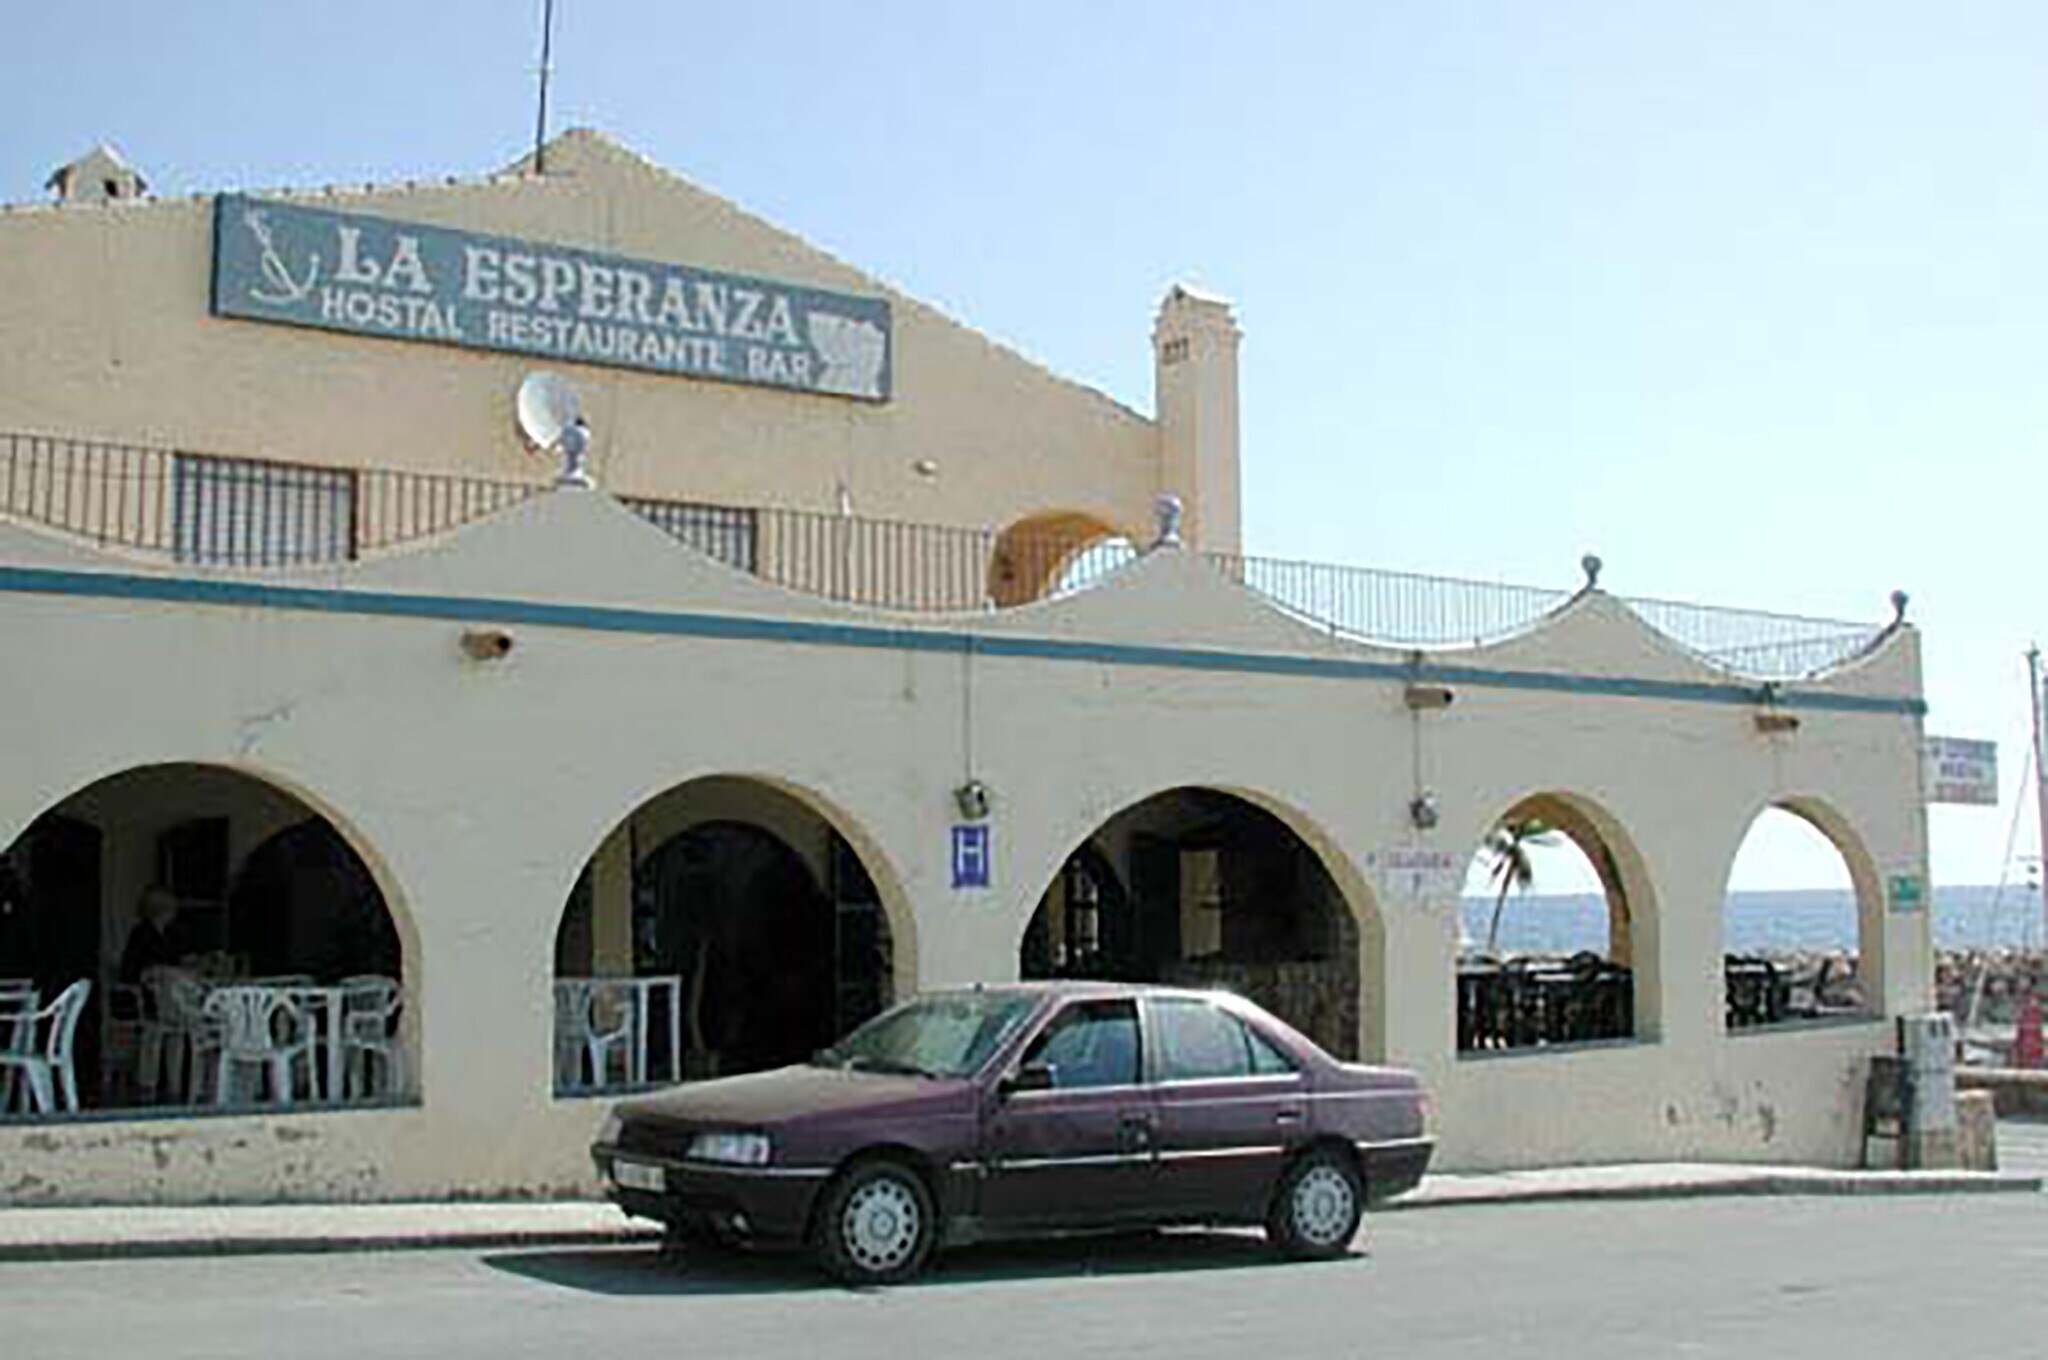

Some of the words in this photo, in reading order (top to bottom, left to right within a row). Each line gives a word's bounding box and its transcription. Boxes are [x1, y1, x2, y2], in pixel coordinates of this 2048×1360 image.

[334, 225, 433, 293] LA
[463, 246, 800, 347] ESPERANZA
[321, 287, 465, 337] HOSTAL
[487, 309, 727, 371] RESTAURANTE
[747, 347, 811, 387] BAR
[957, 830, 984, 875] H
